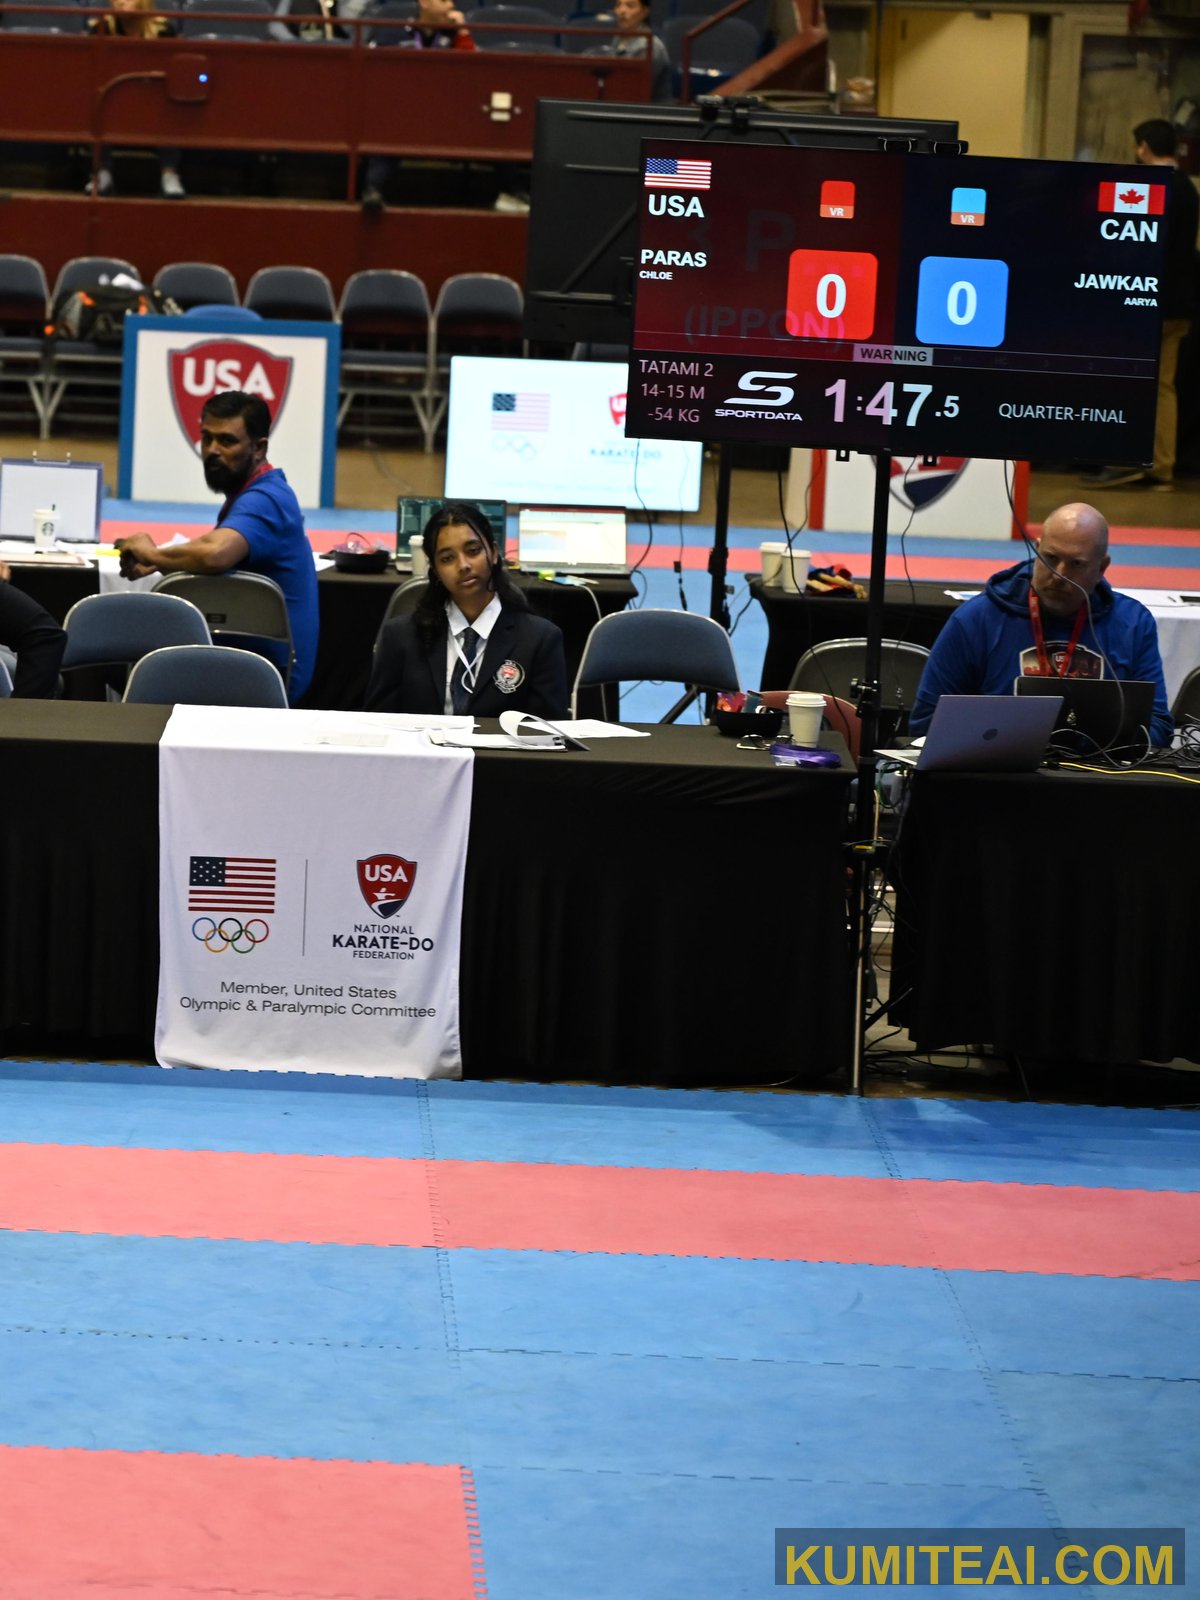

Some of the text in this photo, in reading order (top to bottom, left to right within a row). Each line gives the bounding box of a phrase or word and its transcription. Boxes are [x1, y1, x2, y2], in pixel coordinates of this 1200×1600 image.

[648, 194, 705, 218] USA
[829, 207, 844, 217] VR
[960, 214, 975, 224] VR
[1100, 218, 1158, 243] CAN
[641, 249, 708, 268] PARAS
[639, 270, 673, 280] CHLOE
[1074, 273, 1158, 292] JAWKAR
[816, 273, 847, 319] 0
[947, 280, 977, 326] 0
[1124, 297, 1158, 307] AARYA
[860, 347, 928, 363] WARNING
[639, 359, 714, 377] TATAMI 2
[183, 357, 275, 400] USA
[641, 384, 705, 400] 14-15 M
[647, 407, 700, 423] -54 KG
[714, 408, 803, 422] SPORTDATA
[998, 402, 1127, 424] QUARTER-FINAL
[364, 864, 408, 883] USA
[354, 924, 415, 935] NATIONAL
[332, 934, 434, 952] KARATE-DO
[353, 950, 415, 960] FEDERATION
[221, 981, 397, 999] Member, United States
[179, 997, 437, 1018] Olympic & Paralympic Committee
